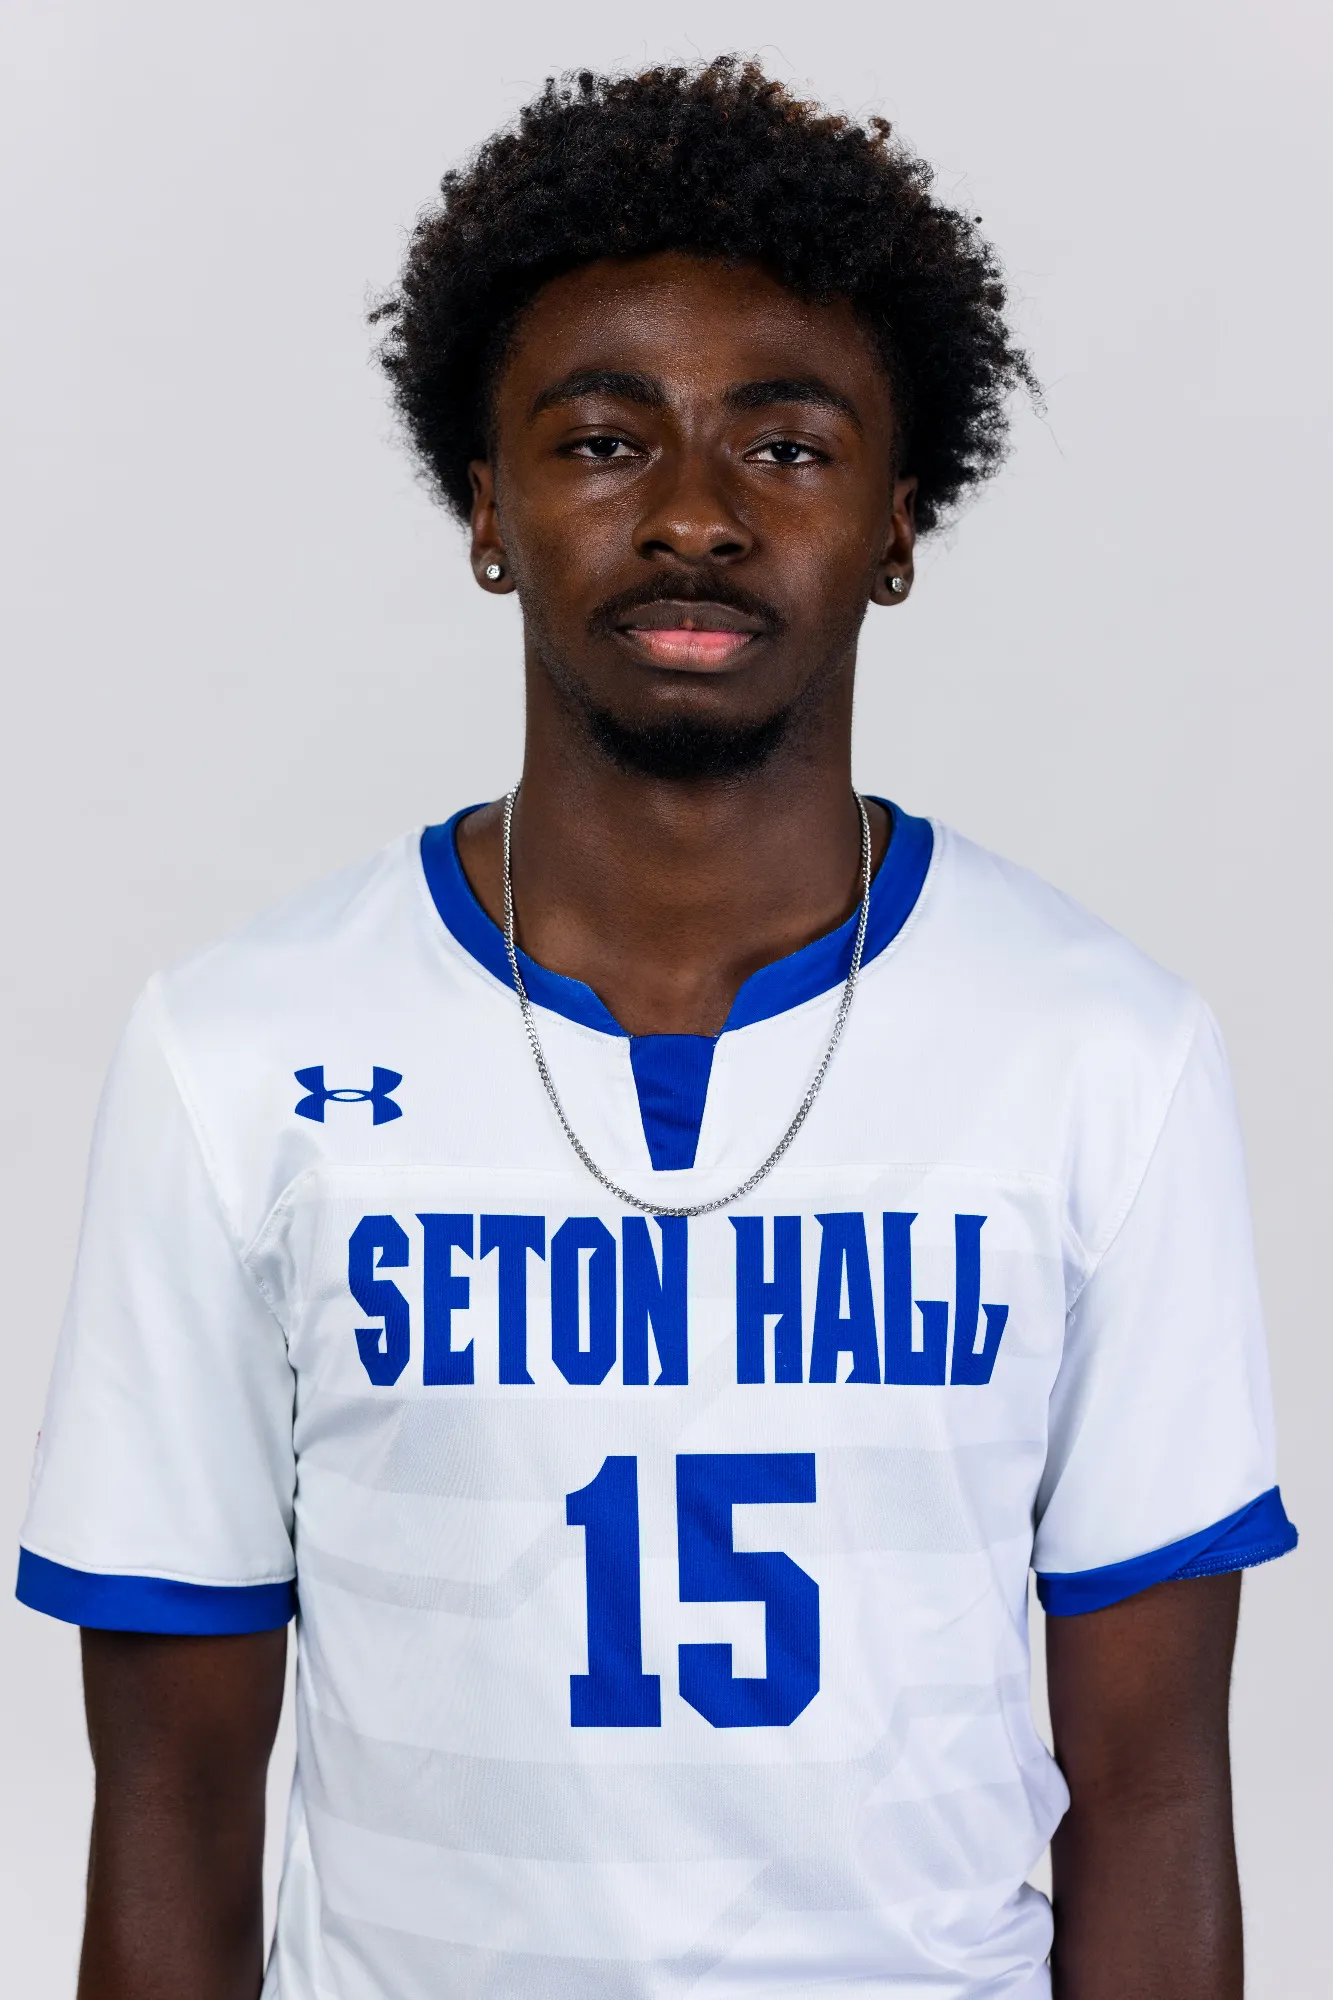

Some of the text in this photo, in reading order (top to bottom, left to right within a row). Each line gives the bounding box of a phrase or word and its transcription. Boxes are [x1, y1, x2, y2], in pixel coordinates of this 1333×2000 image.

[347, 1211, 1010, 1387] SETON HALL
[565, 1453, 821, 1729] 15
